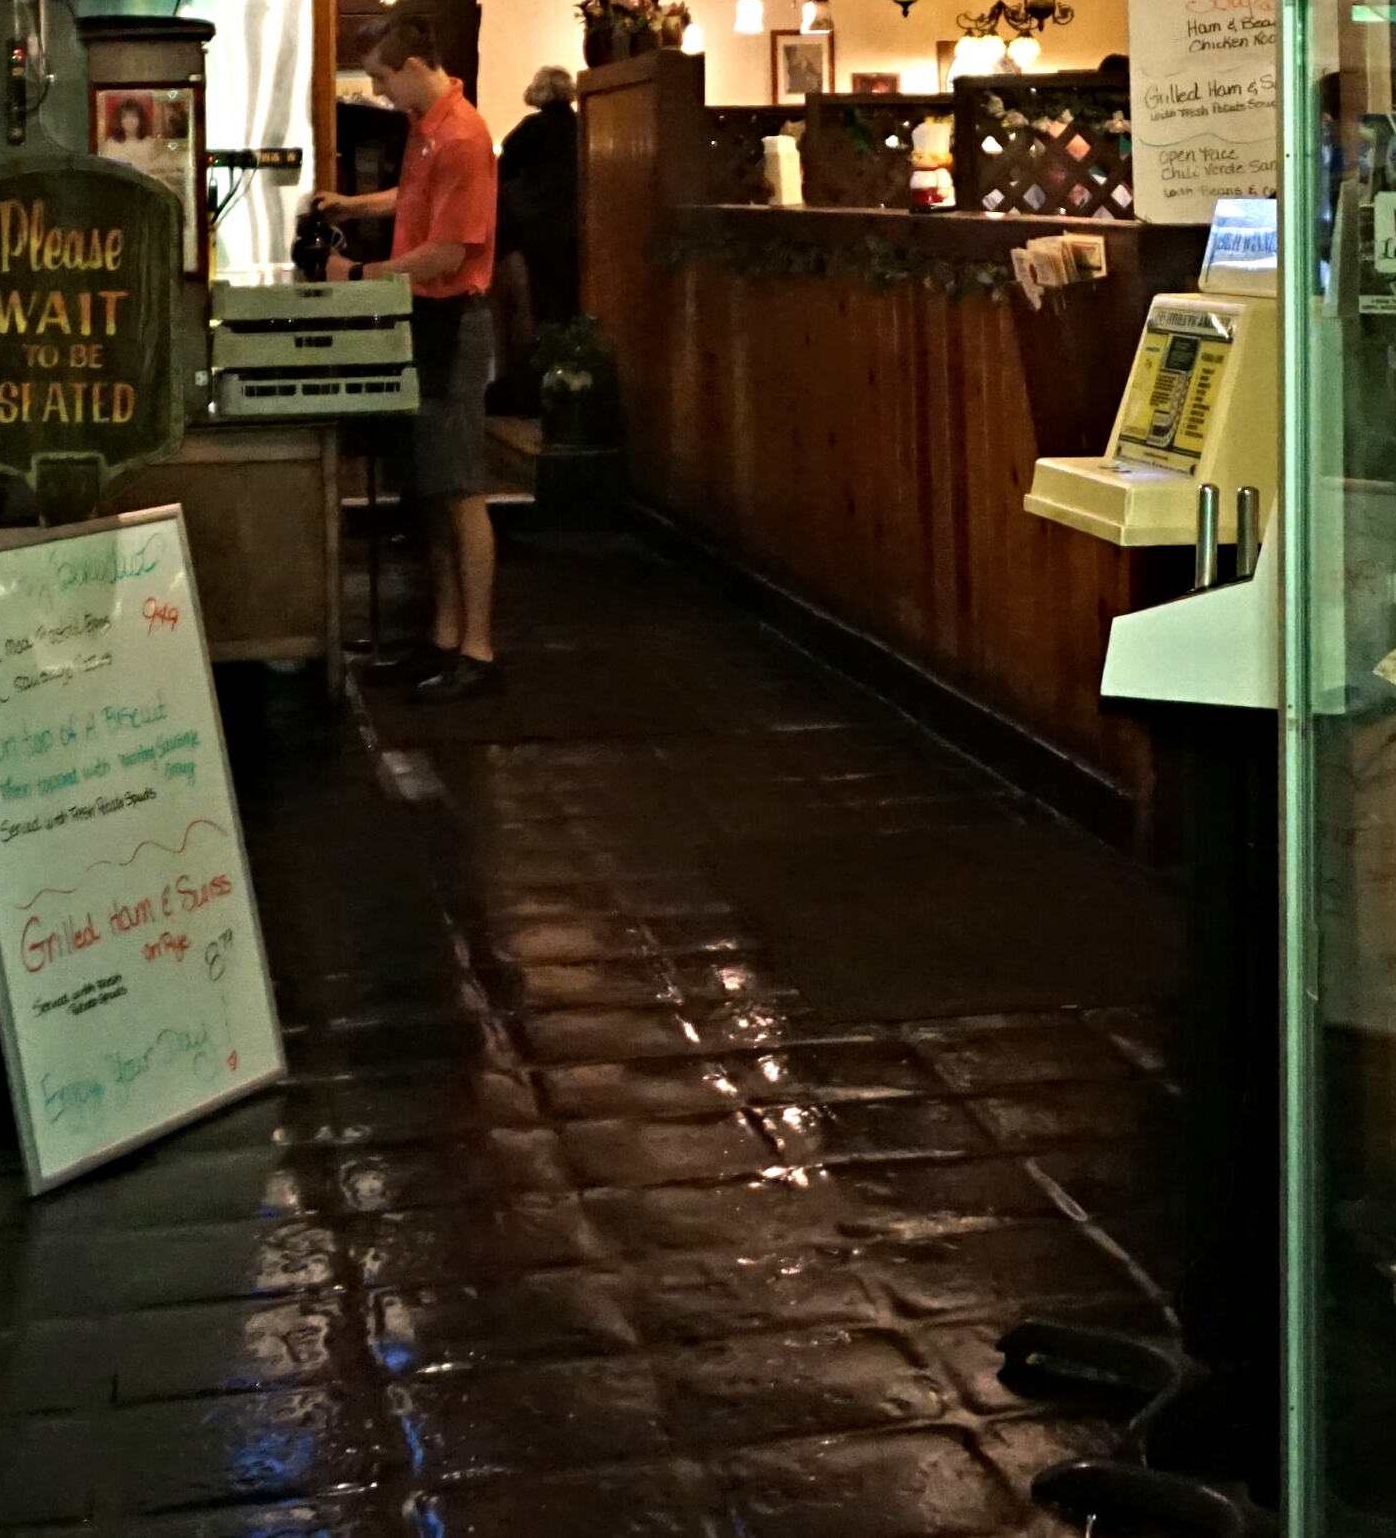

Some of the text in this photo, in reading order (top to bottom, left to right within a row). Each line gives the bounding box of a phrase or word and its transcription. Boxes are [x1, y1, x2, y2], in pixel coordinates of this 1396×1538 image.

[1187, 19, 1221, 38] Ham
[1241, 17, 1276, 31] Bea
[1189, 31, 1276, 53] Chicken Noo
[1145, 82, 1202, 109] Grilled
[1208, 80, 1241, 98] Ham
[1159, 149, 1195, 165] Open
[1204, 162, 1245, 175] Verde
[1249, 160, 1277, 174] San
[23, 343, 103, 368] TO BE
[0, 818, 42, 842] Served
[21, 911, 101, 973] Grilled
[110, 898, 155, 935] Ham
[175, 874, 232, 912] Swiss
